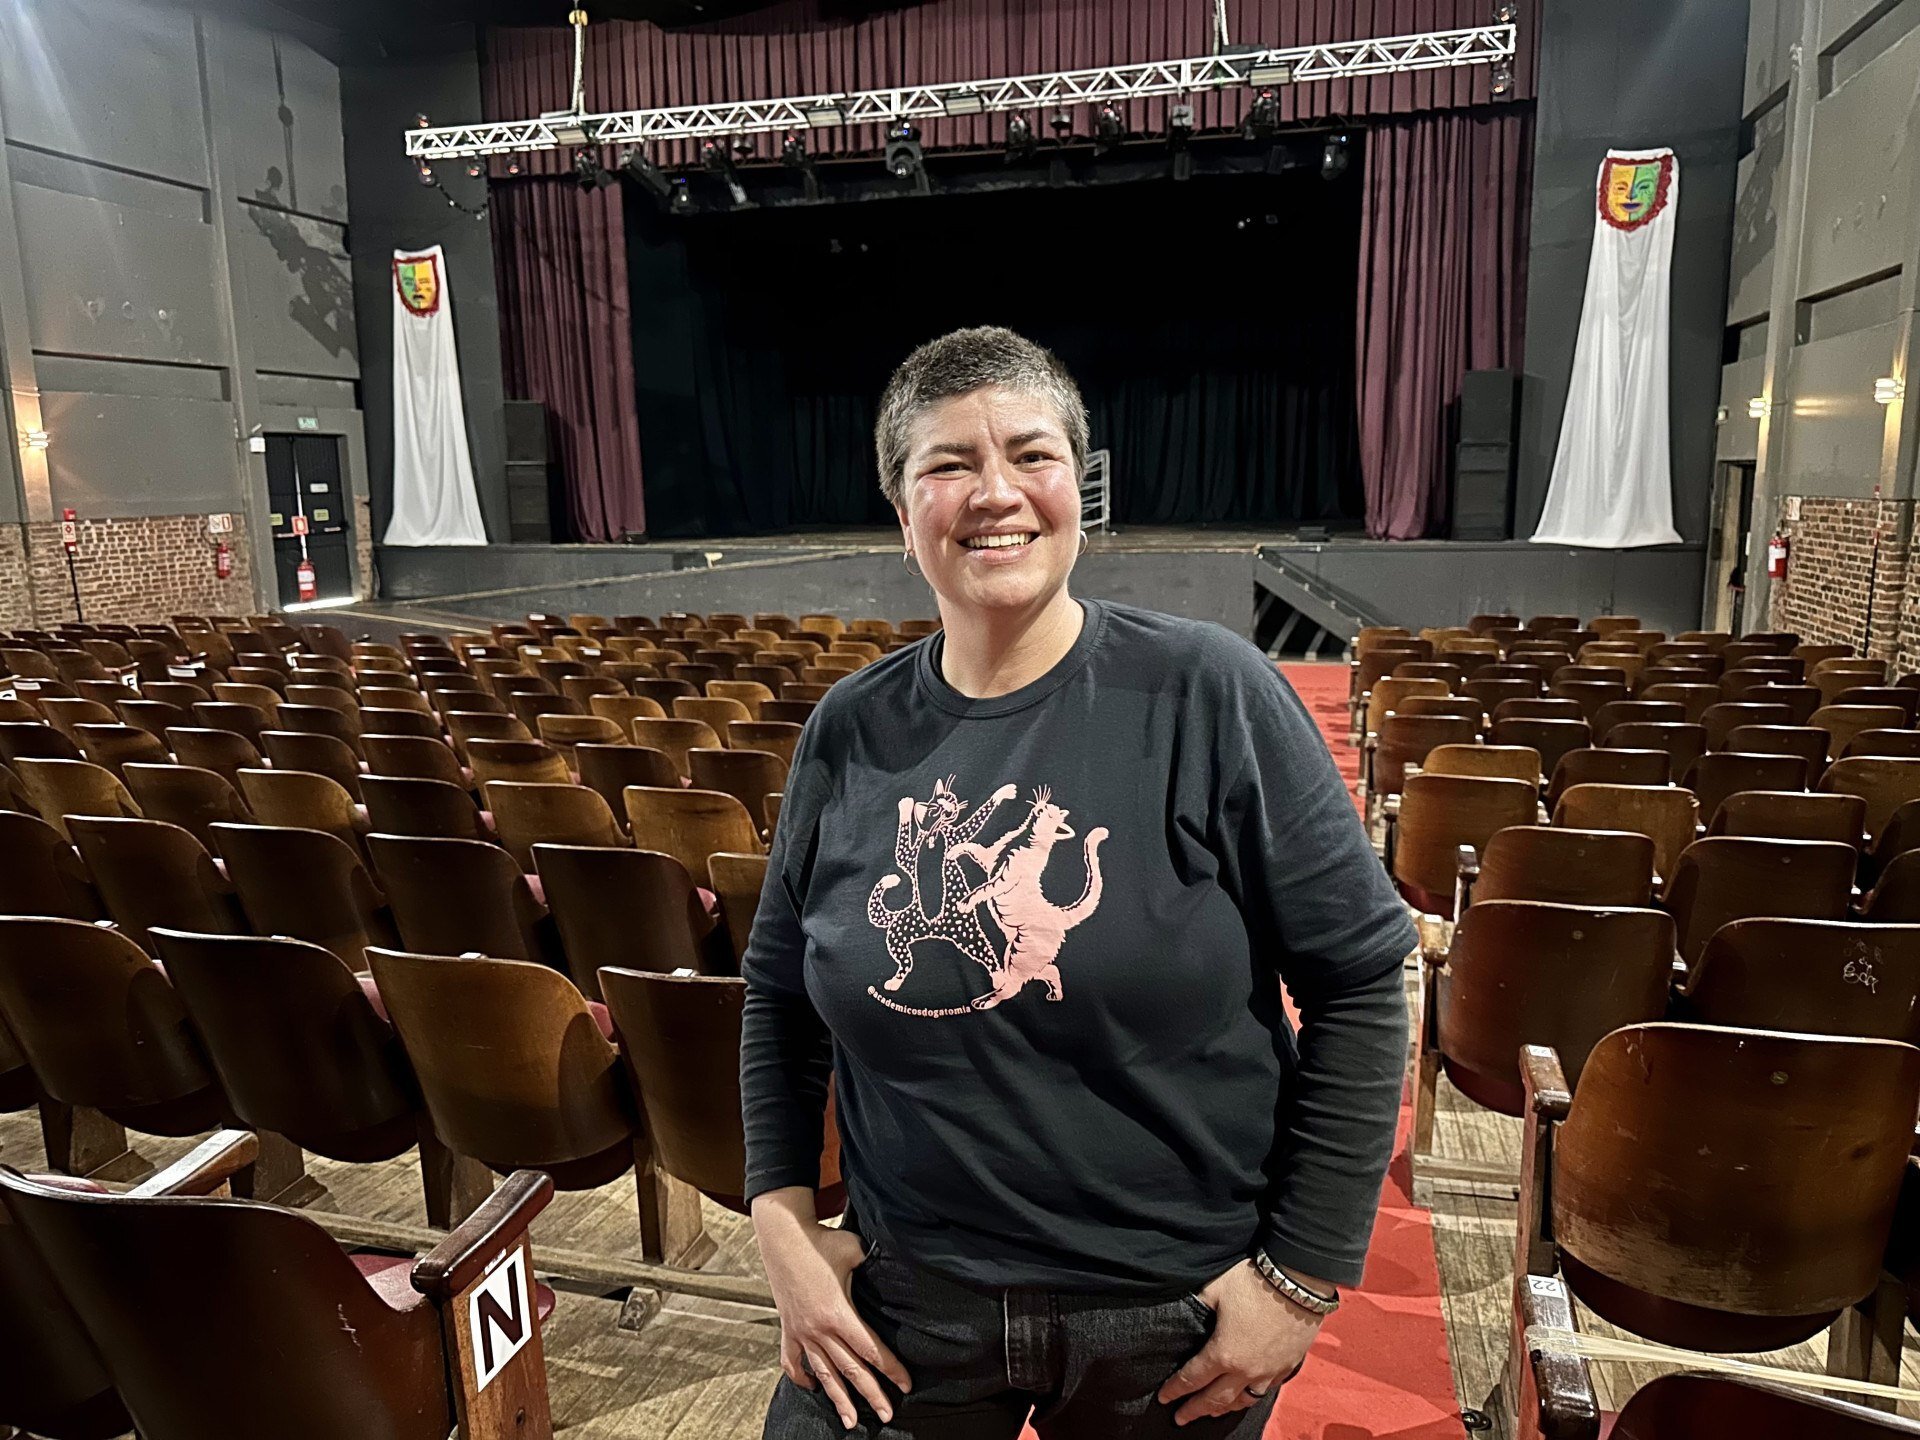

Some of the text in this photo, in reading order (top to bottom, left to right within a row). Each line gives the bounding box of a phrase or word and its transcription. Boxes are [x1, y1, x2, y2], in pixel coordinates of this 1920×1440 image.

[867, 985, 971, 1018] @academicosdogatomia
[1531, 1279, 1557, 1292] 22
[476, 1260, 524, 1376] N
